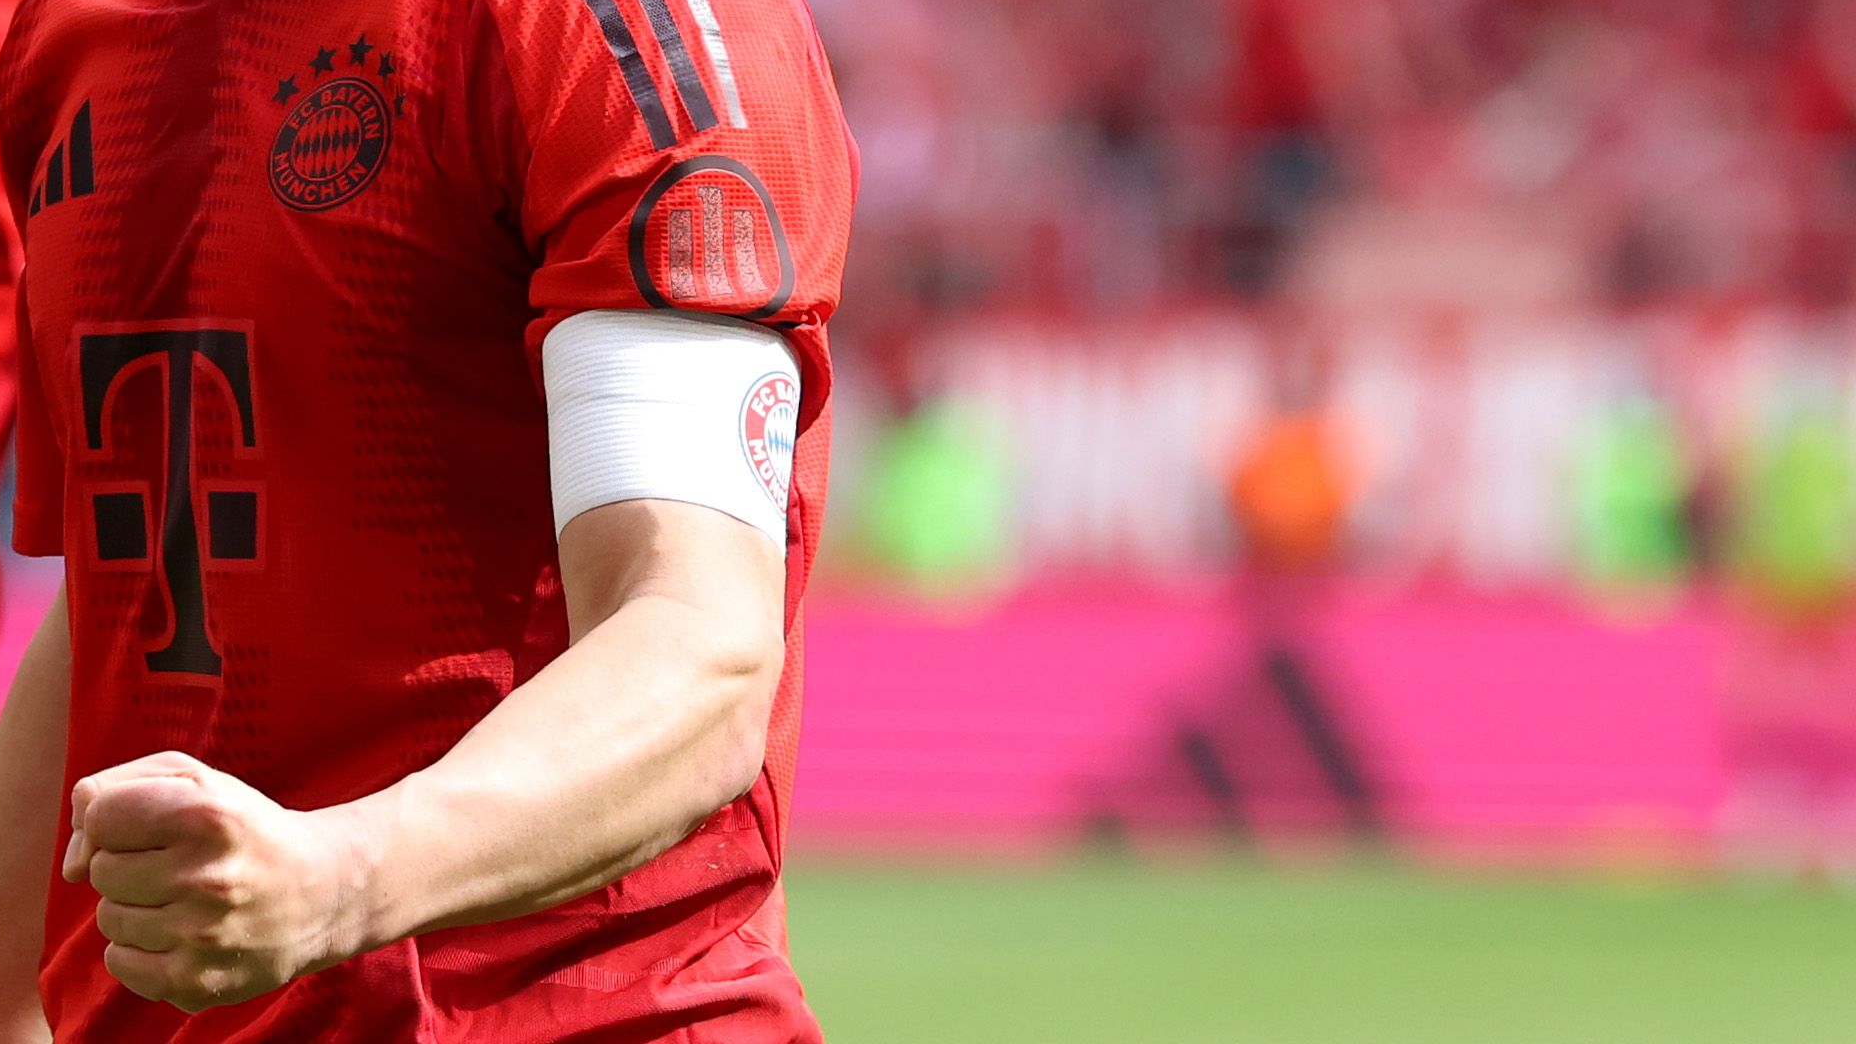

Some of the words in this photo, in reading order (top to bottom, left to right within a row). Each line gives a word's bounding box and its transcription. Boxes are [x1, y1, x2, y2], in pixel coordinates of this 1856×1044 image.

[288, 101, 314, 129] FC
[320, 87, 381, 139] BAYERN
[750, 386, 775, 418] FC
